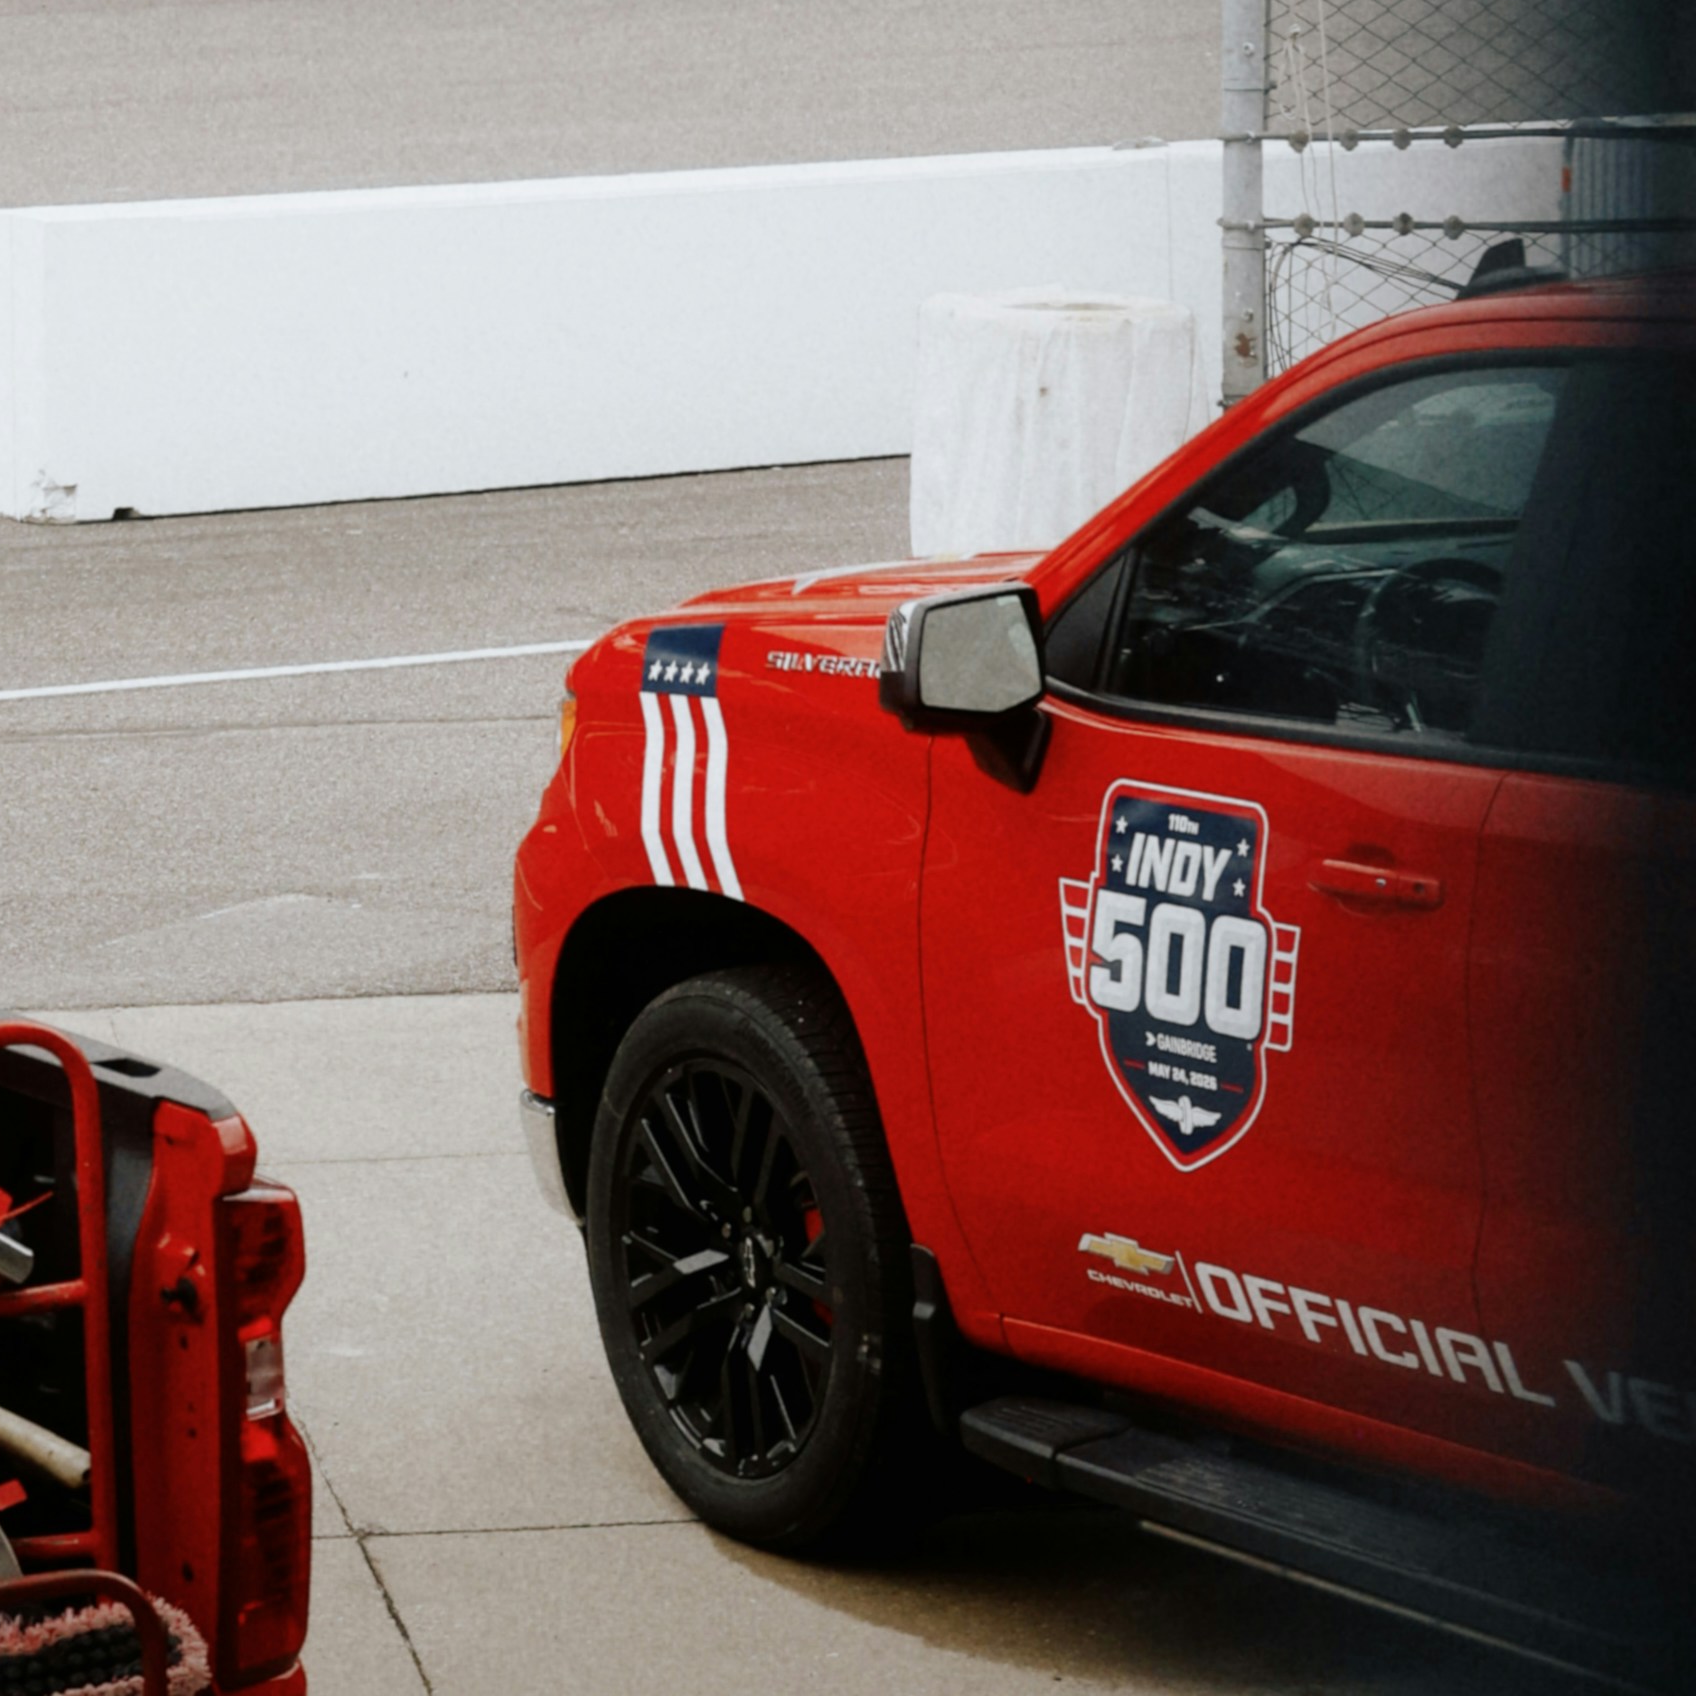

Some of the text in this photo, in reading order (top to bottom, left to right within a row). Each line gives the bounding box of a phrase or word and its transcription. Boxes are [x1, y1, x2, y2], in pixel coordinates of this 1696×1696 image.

[765, 650, 881, 679] SILVERA
[1124, 832, 1233, 902] INDY
[1089, 888, 1268, 1040] 500
[1157, 1032, 1218, 1064] GAINBRIDGE
[1148, 1061, 1171, 1080] MAY
[1086, 1268, 1195, 1309] CHEVROLET
[1194, 1260, 1696, 1446] OFFICIAL VE
